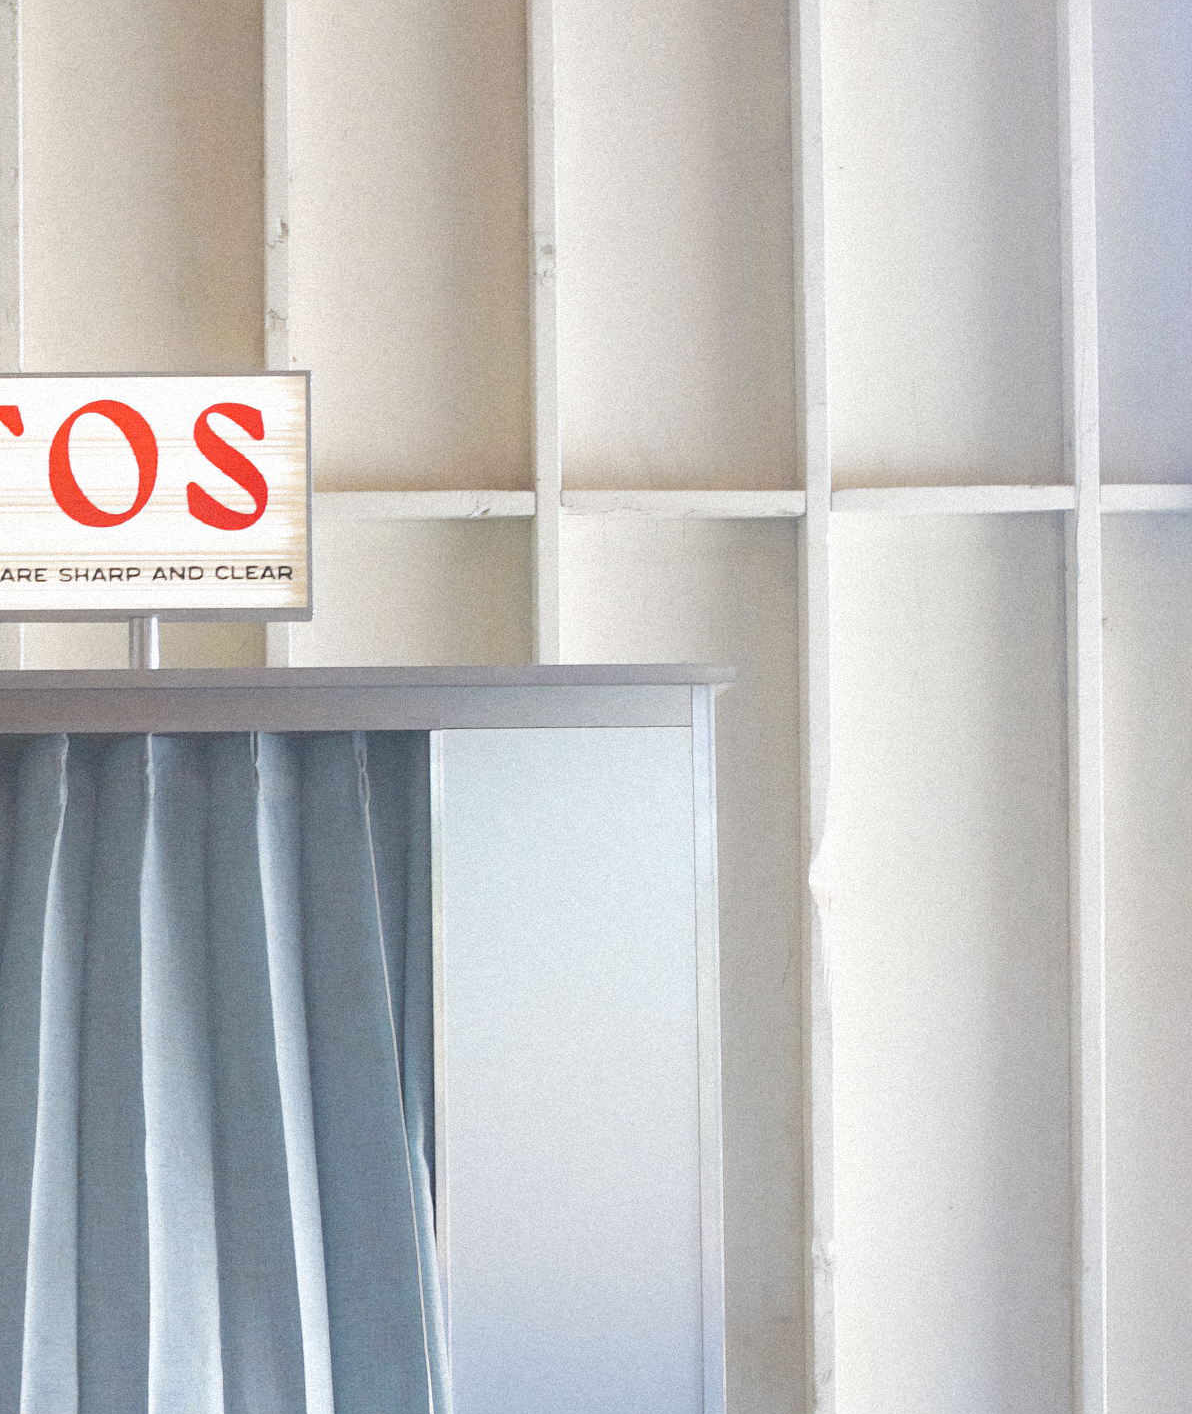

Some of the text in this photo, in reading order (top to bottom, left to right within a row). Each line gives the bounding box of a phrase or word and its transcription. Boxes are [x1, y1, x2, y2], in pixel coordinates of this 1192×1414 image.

[0, 567, 47, 583] ARE
[59, 566, 141, 582] SHARP
[152, 565, 204, 581] AND
[214, 565, 294, 581] CLEAR
